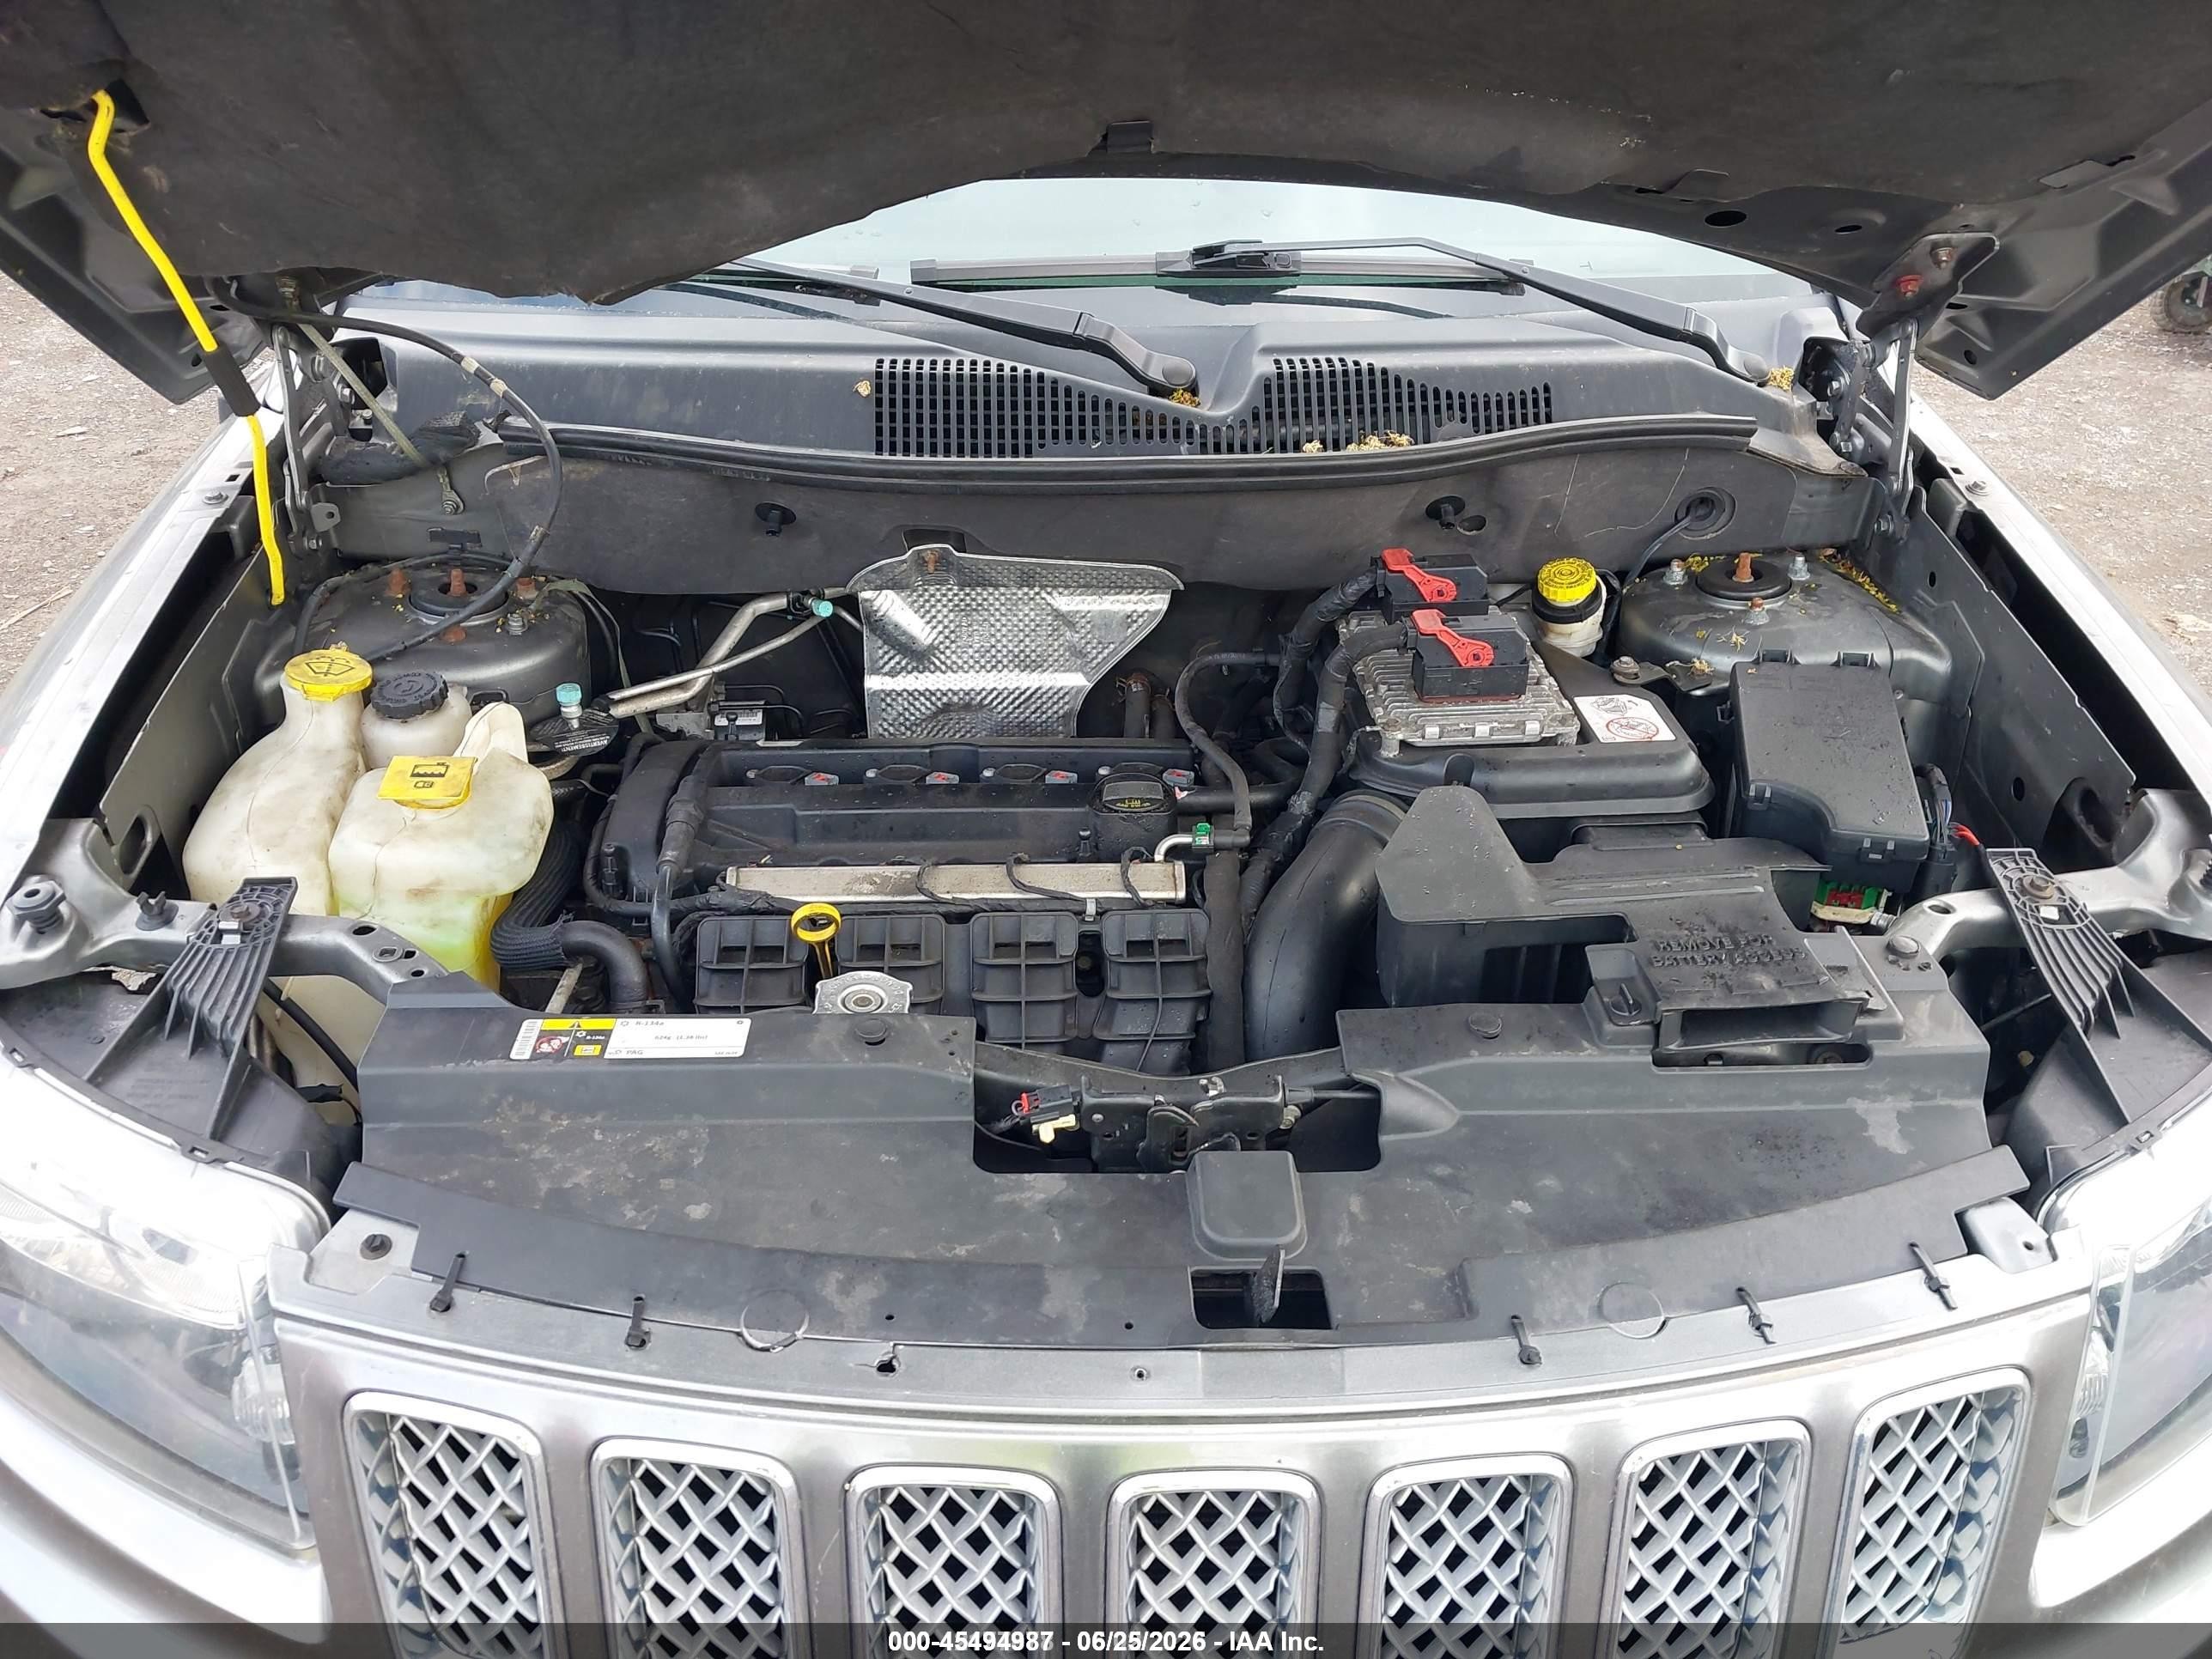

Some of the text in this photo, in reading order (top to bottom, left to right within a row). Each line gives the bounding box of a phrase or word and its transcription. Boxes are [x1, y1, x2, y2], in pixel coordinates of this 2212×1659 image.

[1654, 933, 1774, 952] REMOVE FOR
[1650, 947, 1808, 968] BATTERY ACCESS
